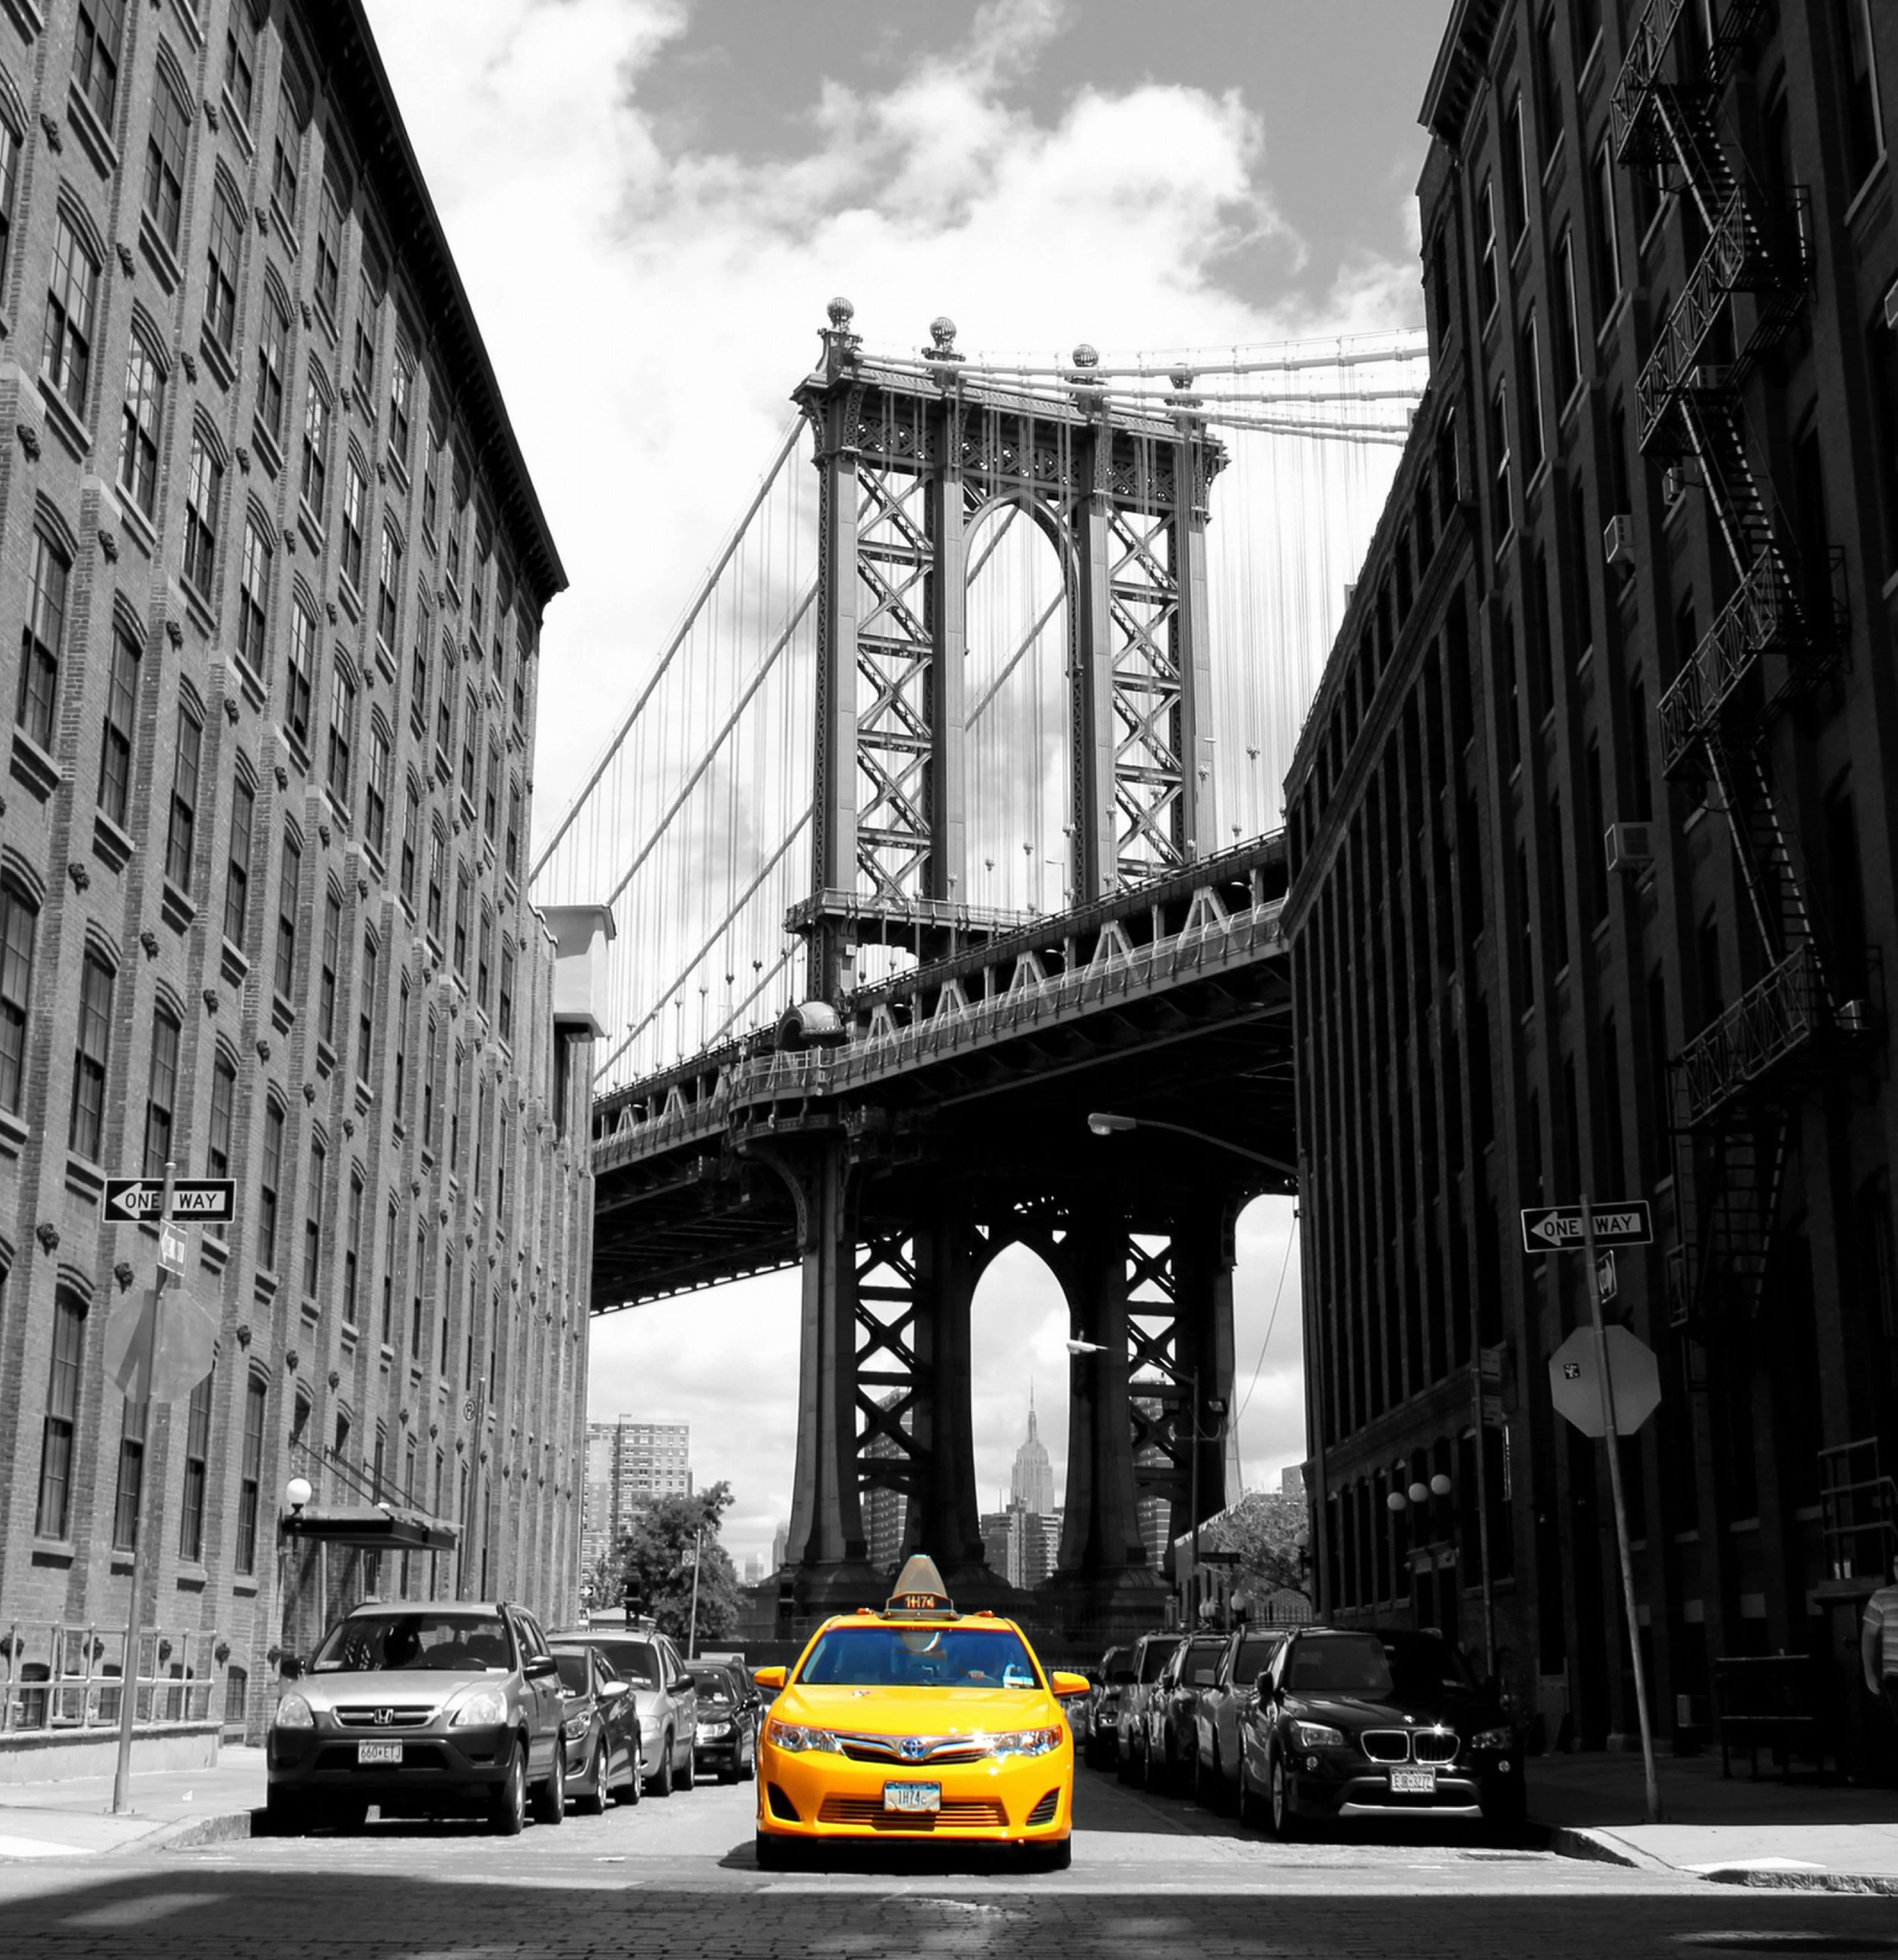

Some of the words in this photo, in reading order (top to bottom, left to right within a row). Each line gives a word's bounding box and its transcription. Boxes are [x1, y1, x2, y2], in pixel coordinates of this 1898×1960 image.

[126, 1193, 160, 1208] ONE
[179, 1193, 217, 1209] WAY
[1543, 1220, 1579, 1237] ONE
[1595, 1215, 1632, 1233] WAY
[905, 1595, 935, 1608] 1H74
